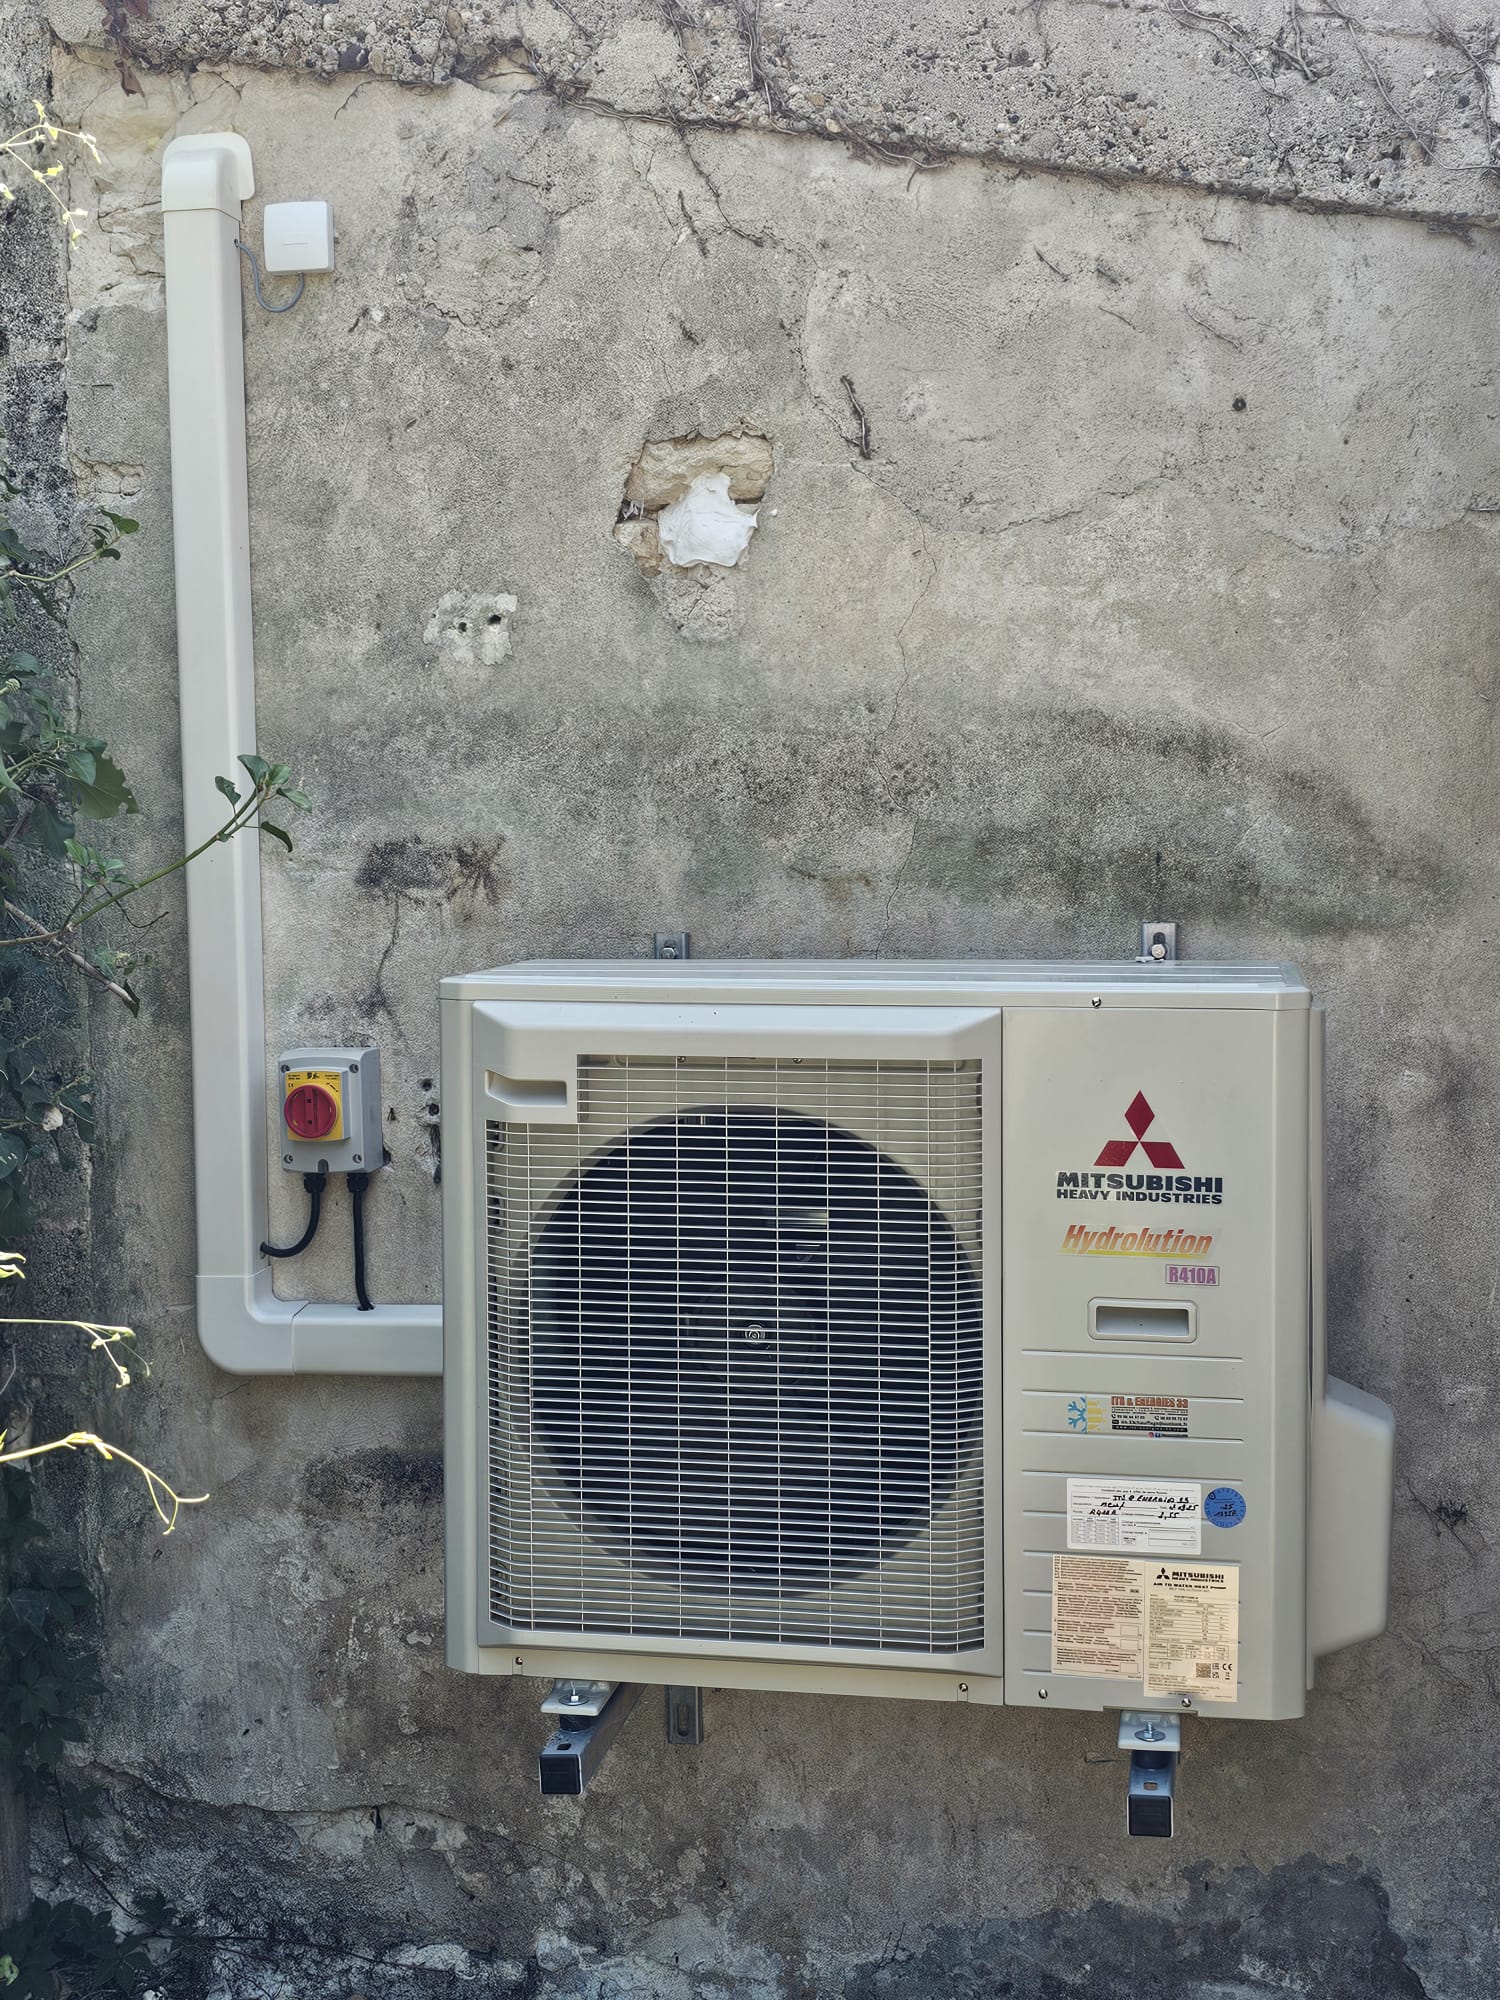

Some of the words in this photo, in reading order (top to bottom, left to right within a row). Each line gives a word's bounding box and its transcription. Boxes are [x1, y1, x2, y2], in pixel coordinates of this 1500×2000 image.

[1057, 1172, 1223, 1193] MITSUBISHI
[1057, 1189, 1110, 1200] HEAVY
[1116, 1191, 1222, 1204] INDUSTRIES
[1063, 1224, 1213, 1254] Hydrolution
[1168, 1267, 1216, 1284] R410A
[1172, 1571, 1224, 1579] MITSUBISHI
